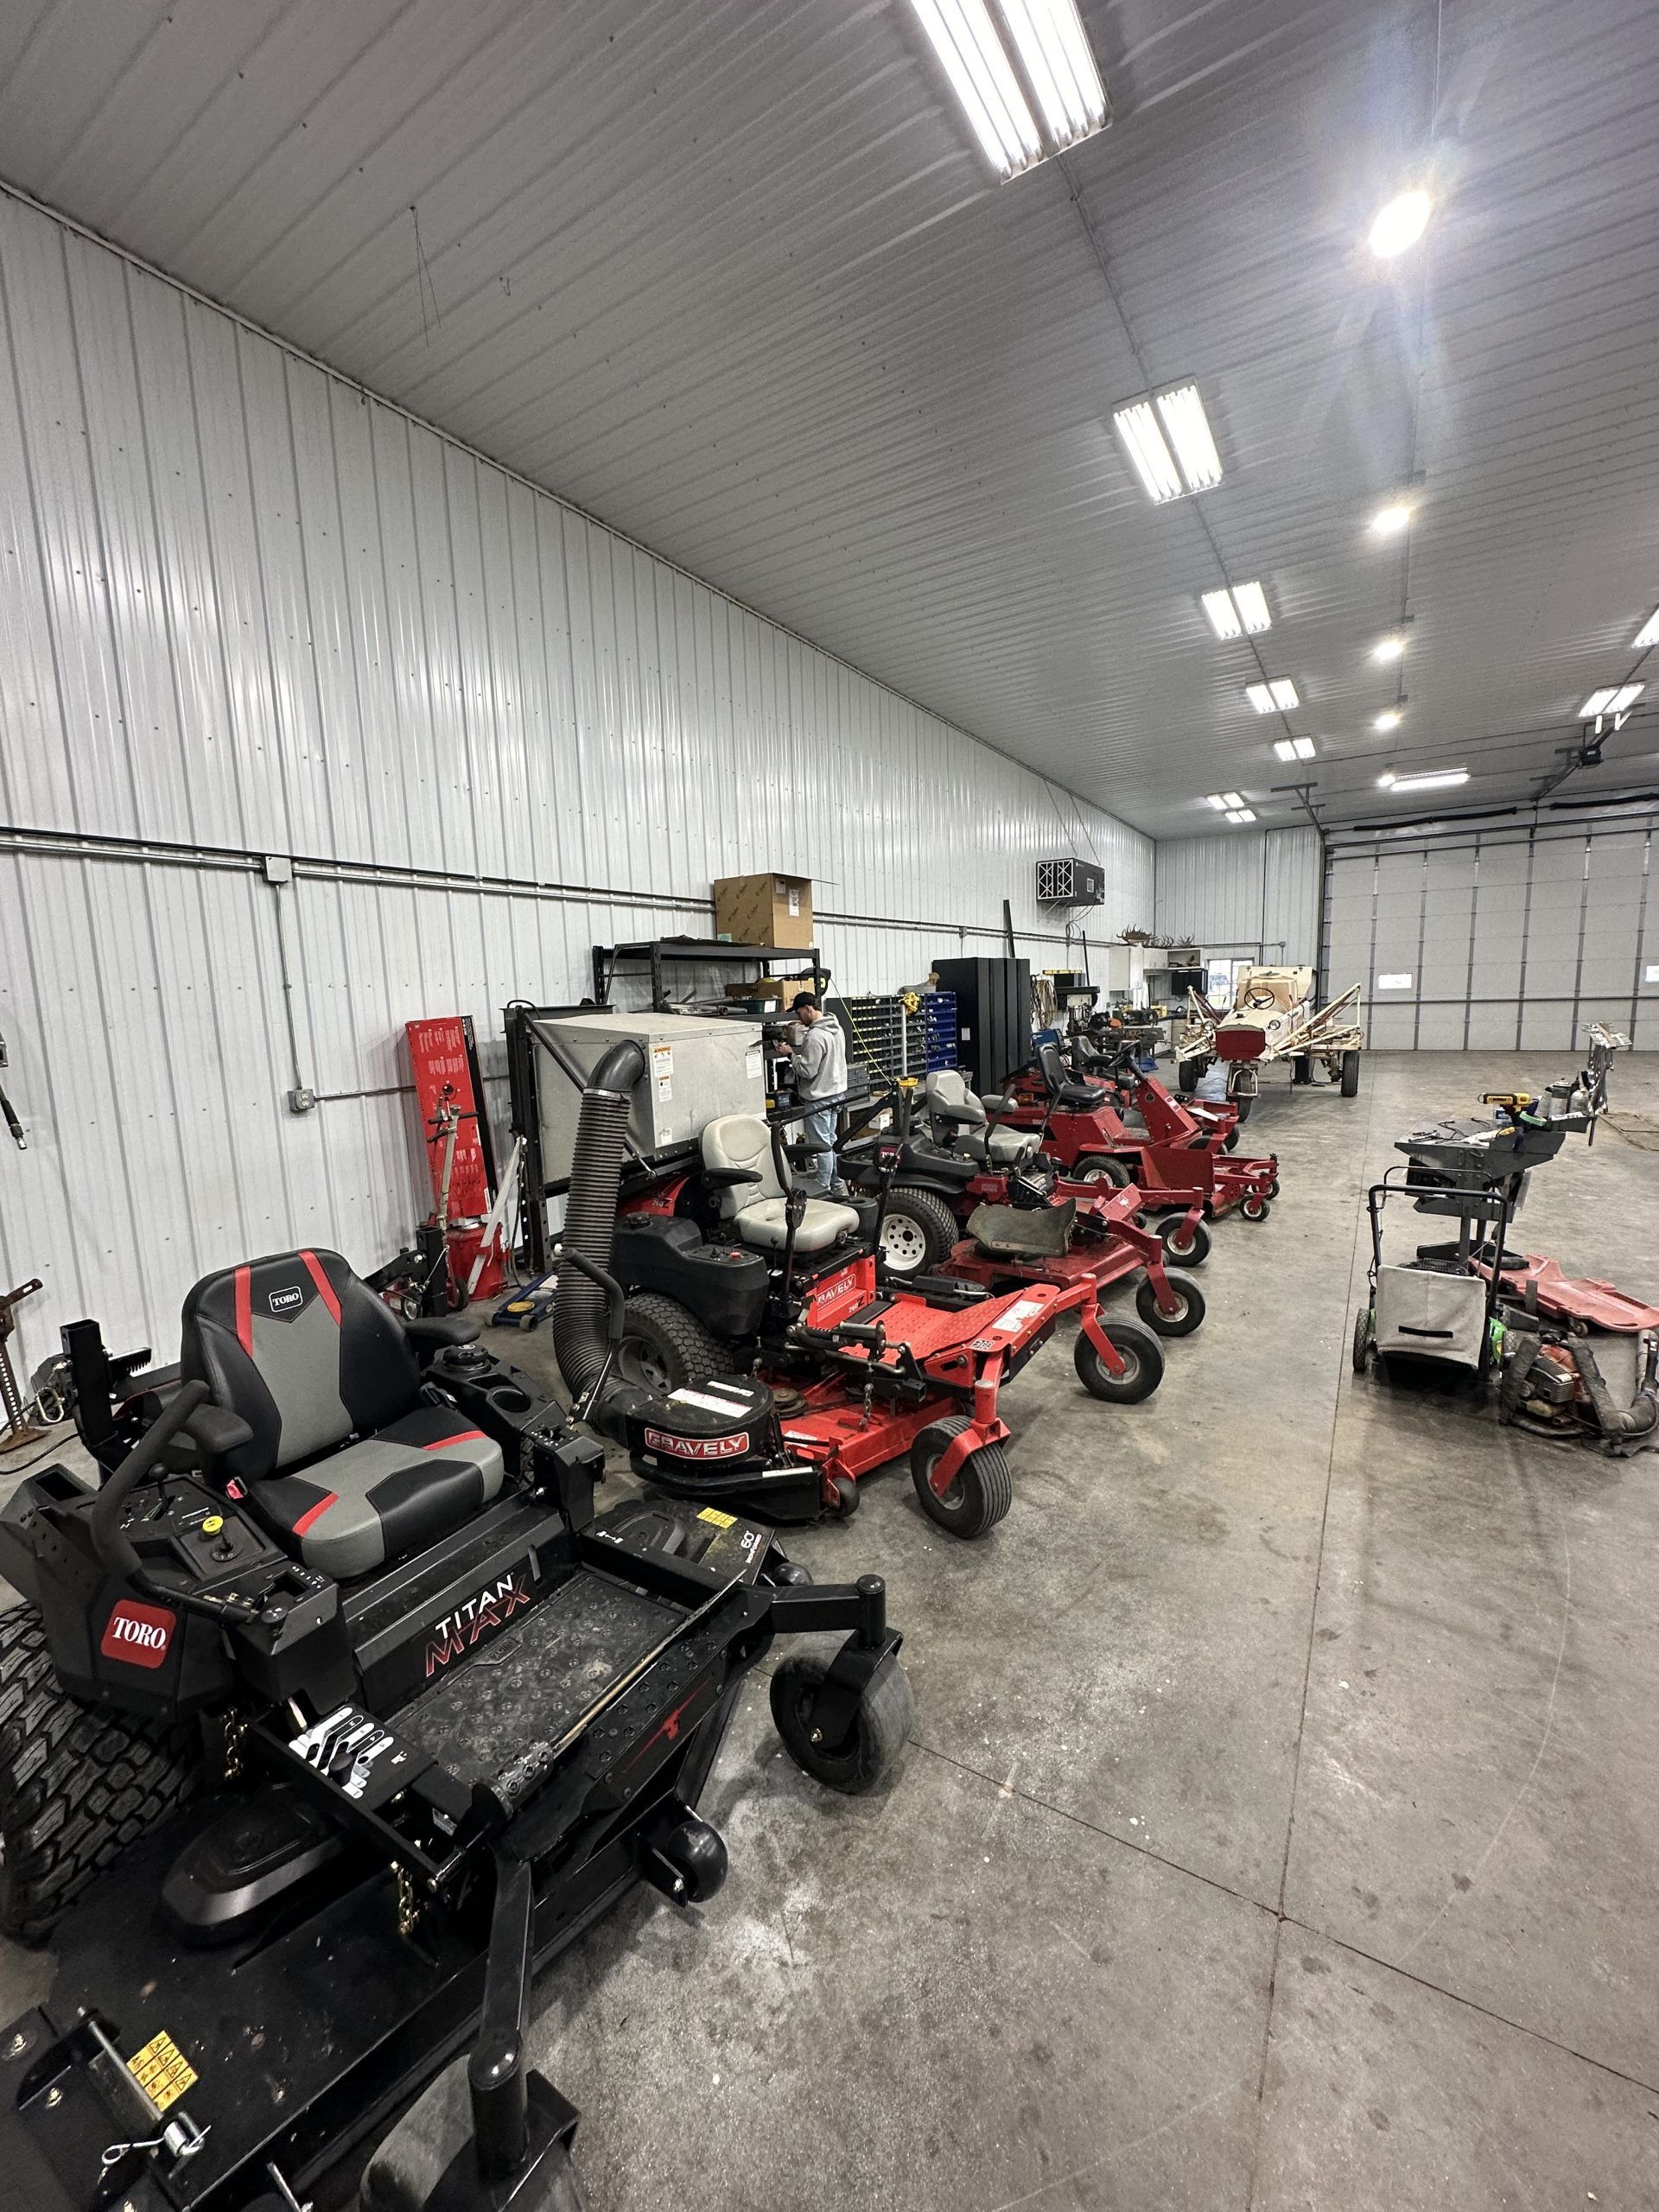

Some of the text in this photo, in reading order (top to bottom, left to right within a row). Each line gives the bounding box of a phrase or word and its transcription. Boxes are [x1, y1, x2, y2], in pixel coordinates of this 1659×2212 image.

[271, 1292, 300, 1306] TORO
[649, 1431, 745, 1456] GRAVELY
[435, 1573, 514, 1639] TITAN
[111, 1616, 167, 1649] TORO
[425, 1573, 531, 1678] MAX
